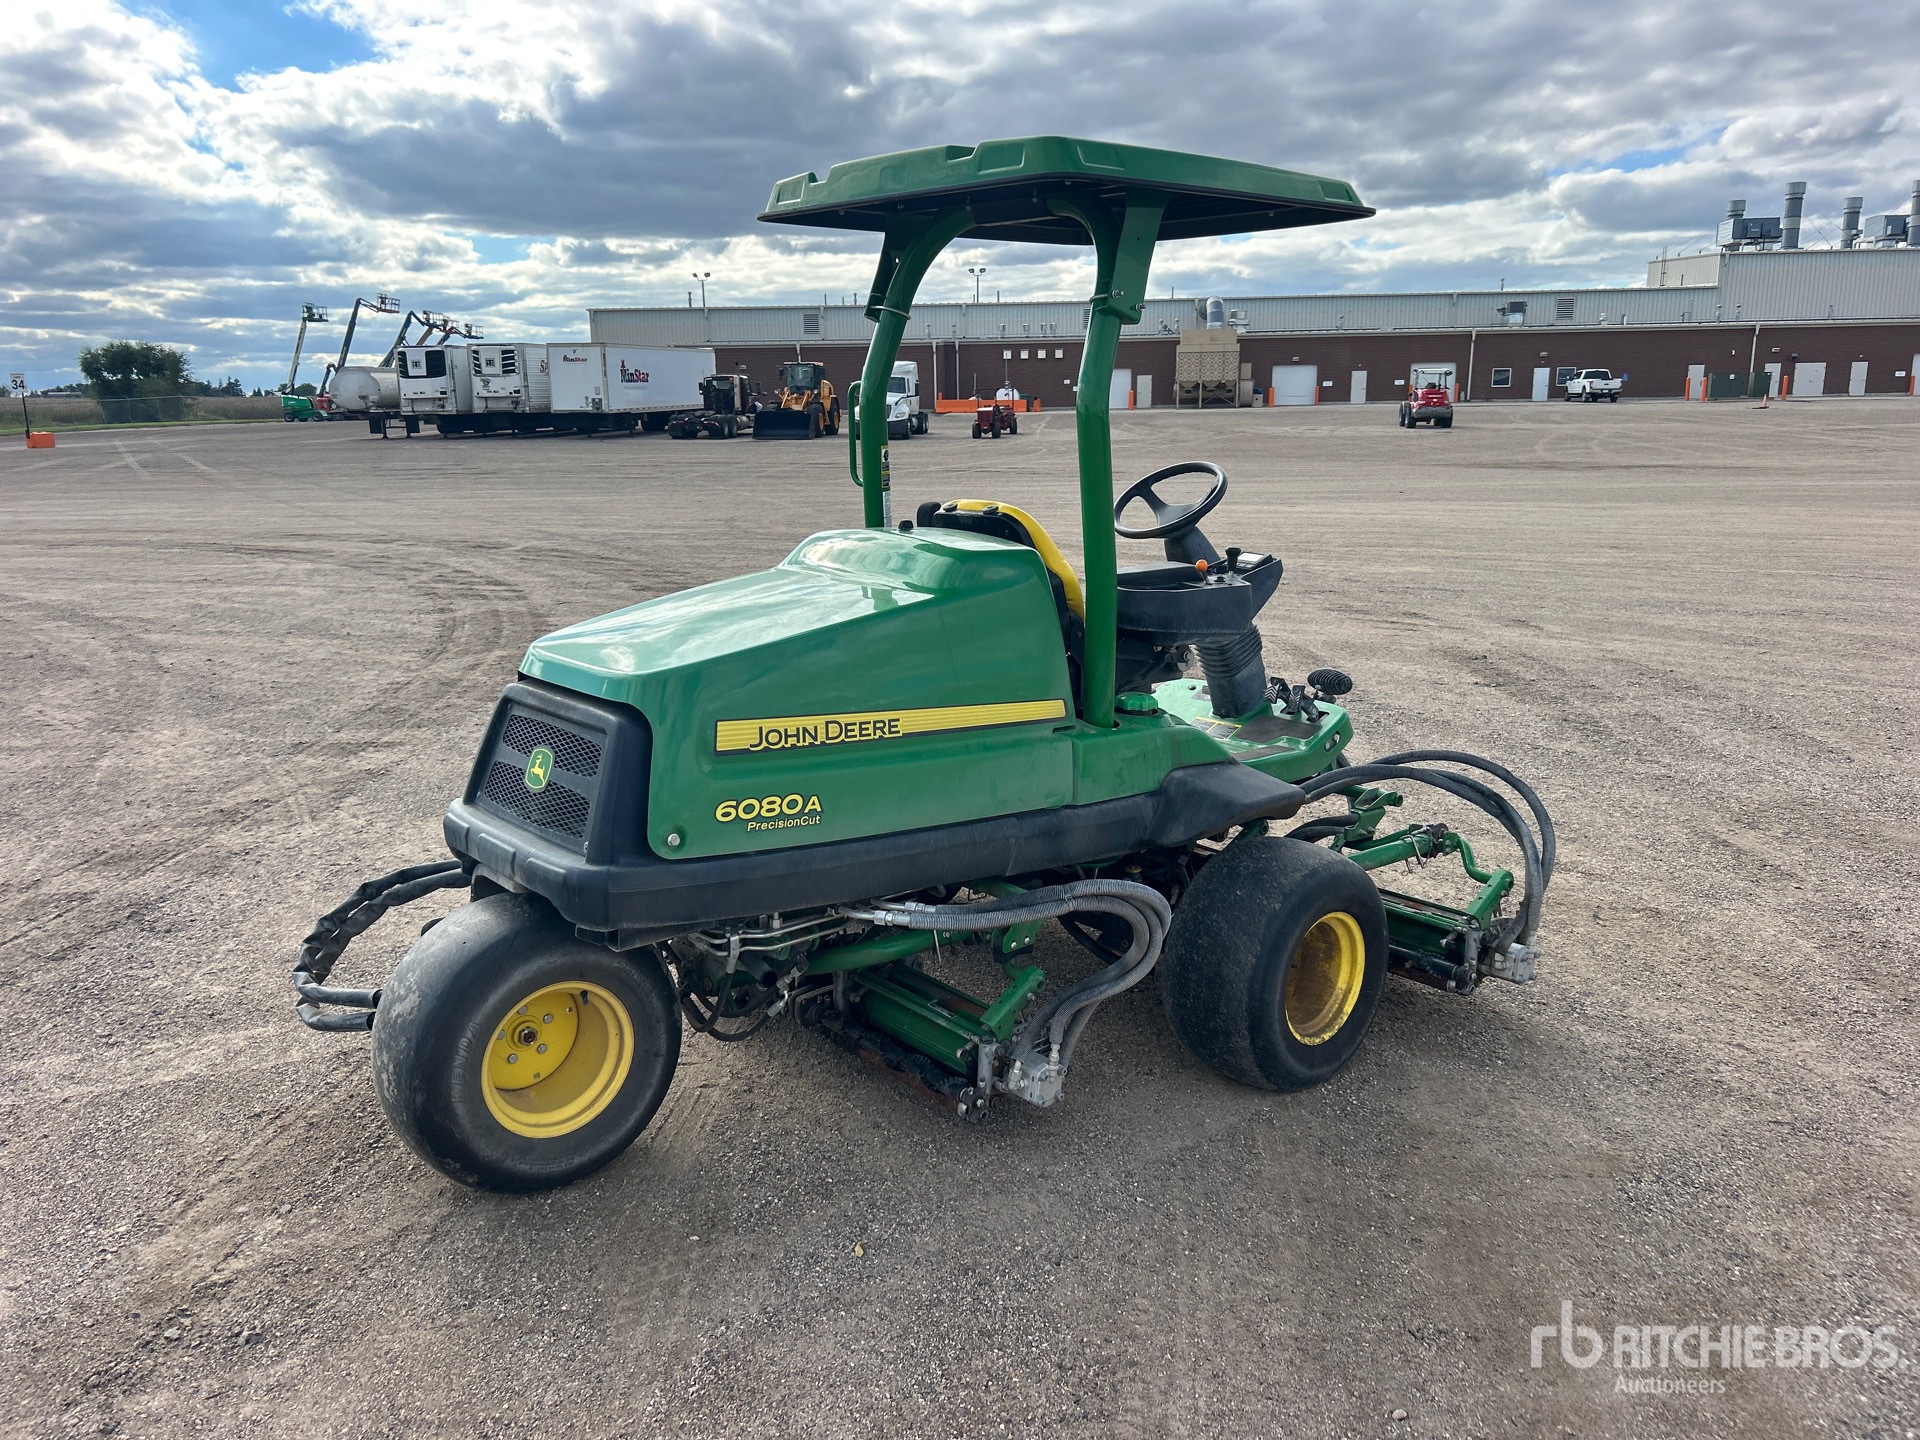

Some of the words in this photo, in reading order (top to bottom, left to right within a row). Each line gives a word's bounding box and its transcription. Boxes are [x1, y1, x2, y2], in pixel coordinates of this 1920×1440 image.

[11, 379, 25, 390] 34
[620, 368, 650, 383] MinStar
[750, 725, 819, 748] JOHN
[824, 718, 901, 742] DEERE
[746, 814, 821, 833] PrecisionCut
[450, 1021, 481, 1104] KENDA
